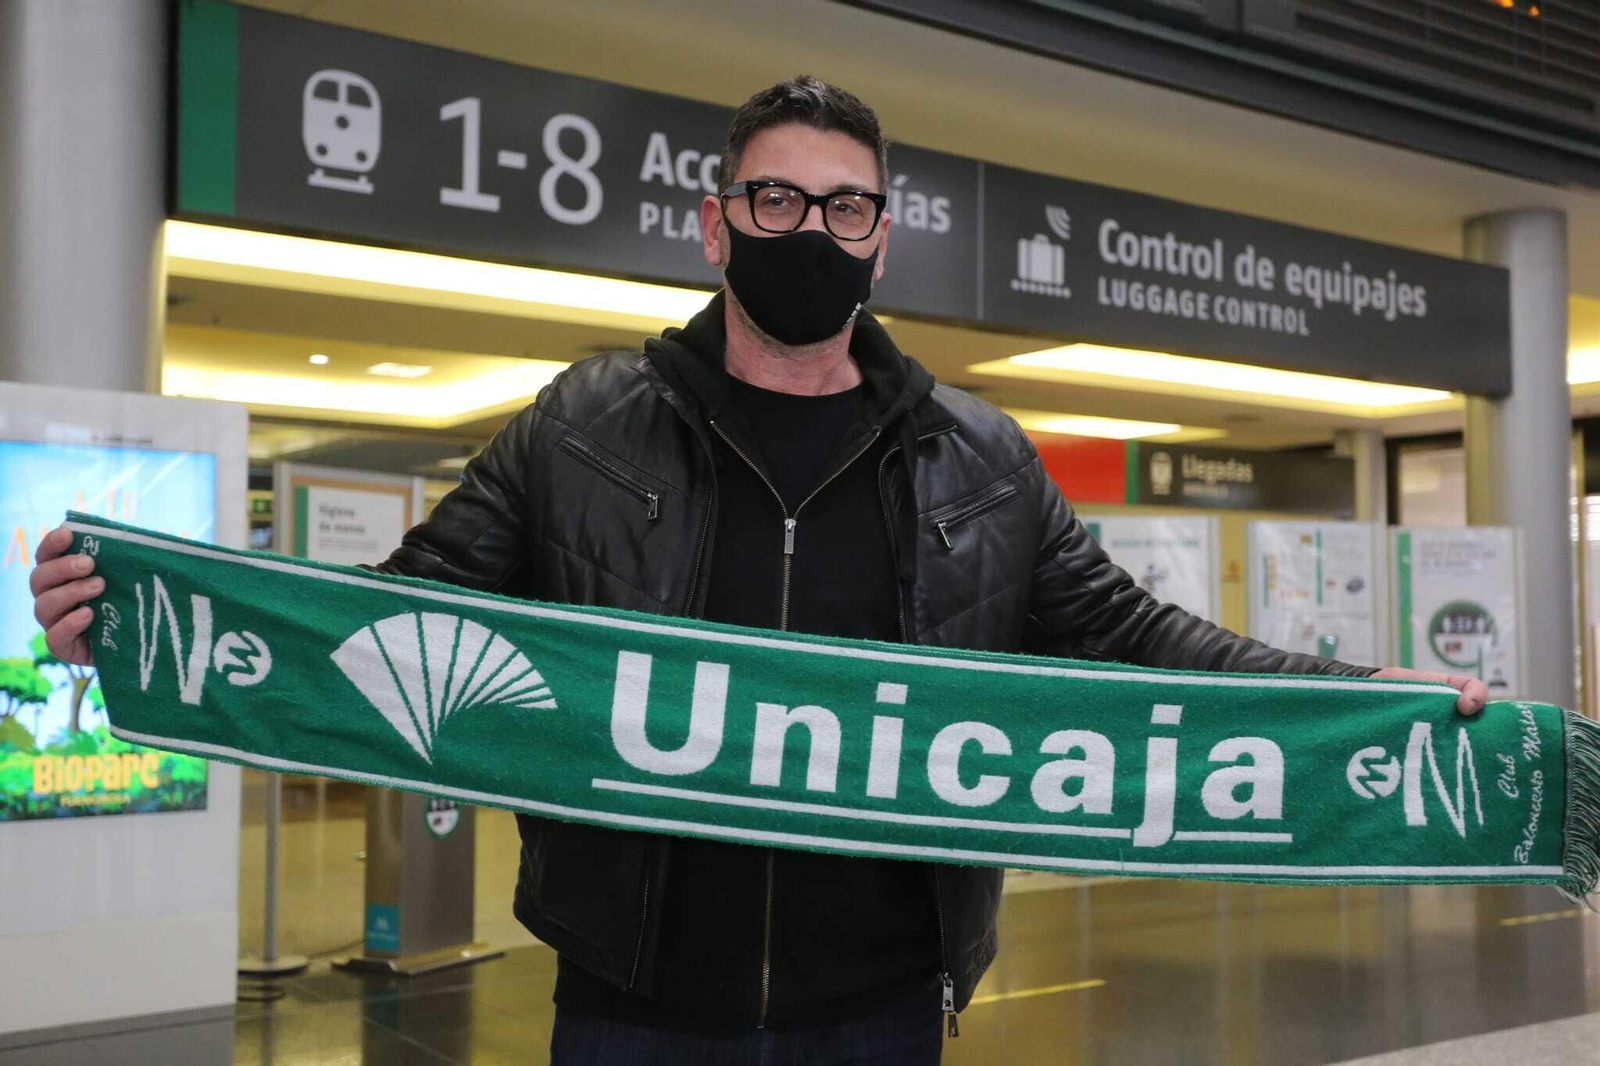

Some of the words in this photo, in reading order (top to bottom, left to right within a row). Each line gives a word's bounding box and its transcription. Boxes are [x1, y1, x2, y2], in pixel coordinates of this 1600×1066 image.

[439, 96, 603, 225] 1-8
[639, 131, 722, 195] Acc
[888, 174, 951, 234] ías
[639, 201, 703, 242] PLA
[1098, 218, 1224, 282] Control
[1234, 244, 1275, 290] de
[1284, 260, 1427, 321] equipajes
[1097, 276, 1210, 320] LUGGAGE
[1213, 294, 1310, 337] CONTROL
[610, 650, 1286, 848] Unicaja
[1497, 752, 1519, 798] Club
[1514, 770, 1543, 864] Baloncesto
